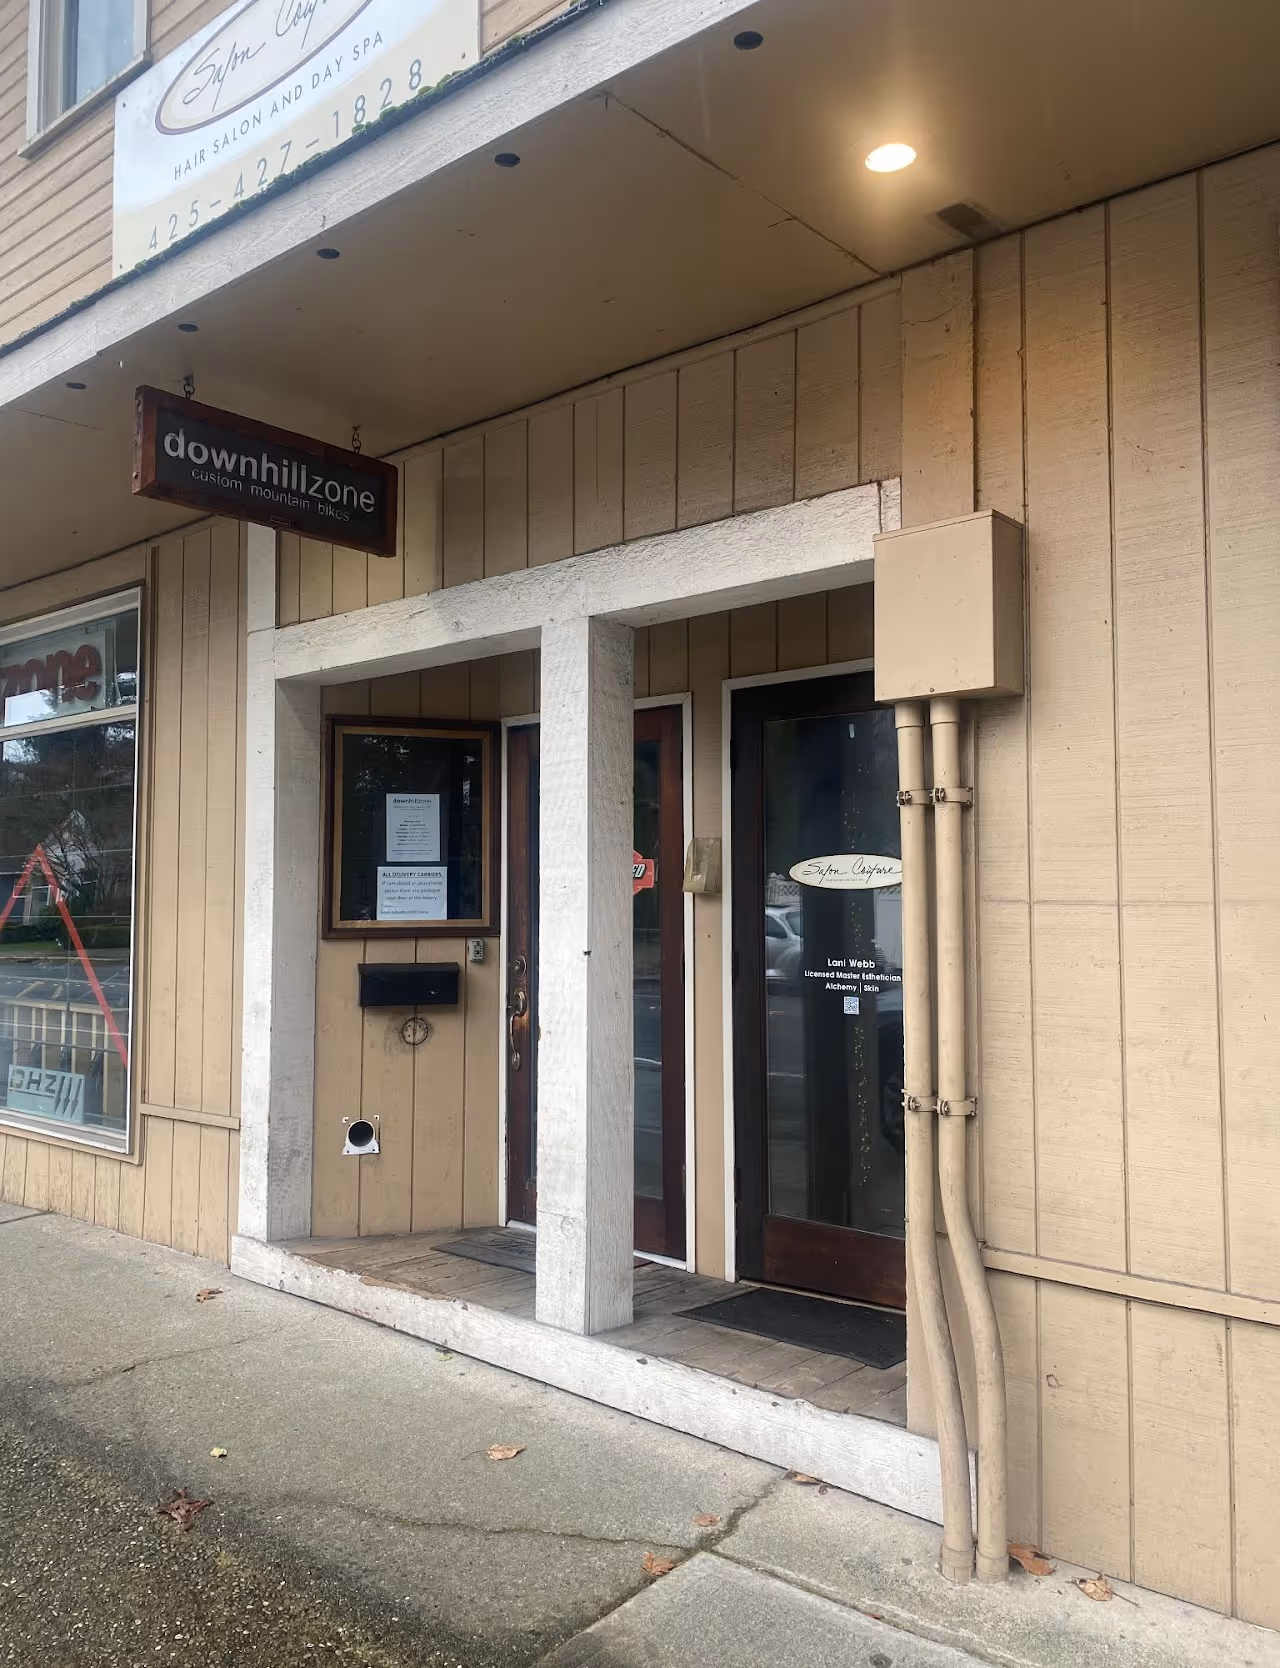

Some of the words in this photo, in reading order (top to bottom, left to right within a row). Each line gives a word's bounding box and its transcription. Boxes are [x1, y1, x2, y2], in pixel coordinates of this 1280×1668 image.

[183, 42, 266, 112] Salon
[174, 149, 206, 181] HAIR
[213, 110, 262, 155] SALON
[270, 84, 303, 118] AND
[312, 55, 343, 90] DAY
[353, 29, 383, 62] SPA
[148, 58, 423, 251] 425-427-1828
[164, 428, 376, 513] downhillzone
[191, 468, 242, 491] custom
[250, 484, 310, 512] mountain
[318, 501, 350, 522] bikes
[802, 861, 848, 885] Salon
[804, 969, 835, 979] Licensed
[836, 971, 860, 980] Master
[861, 972, 902, 982] Esthetician
[825, 982, 857, 992] Alchemy
[863, 984, 880, 993] Skin
[827, 957, 846, 967] Lani
[848, 958, 876, 969] Webb
